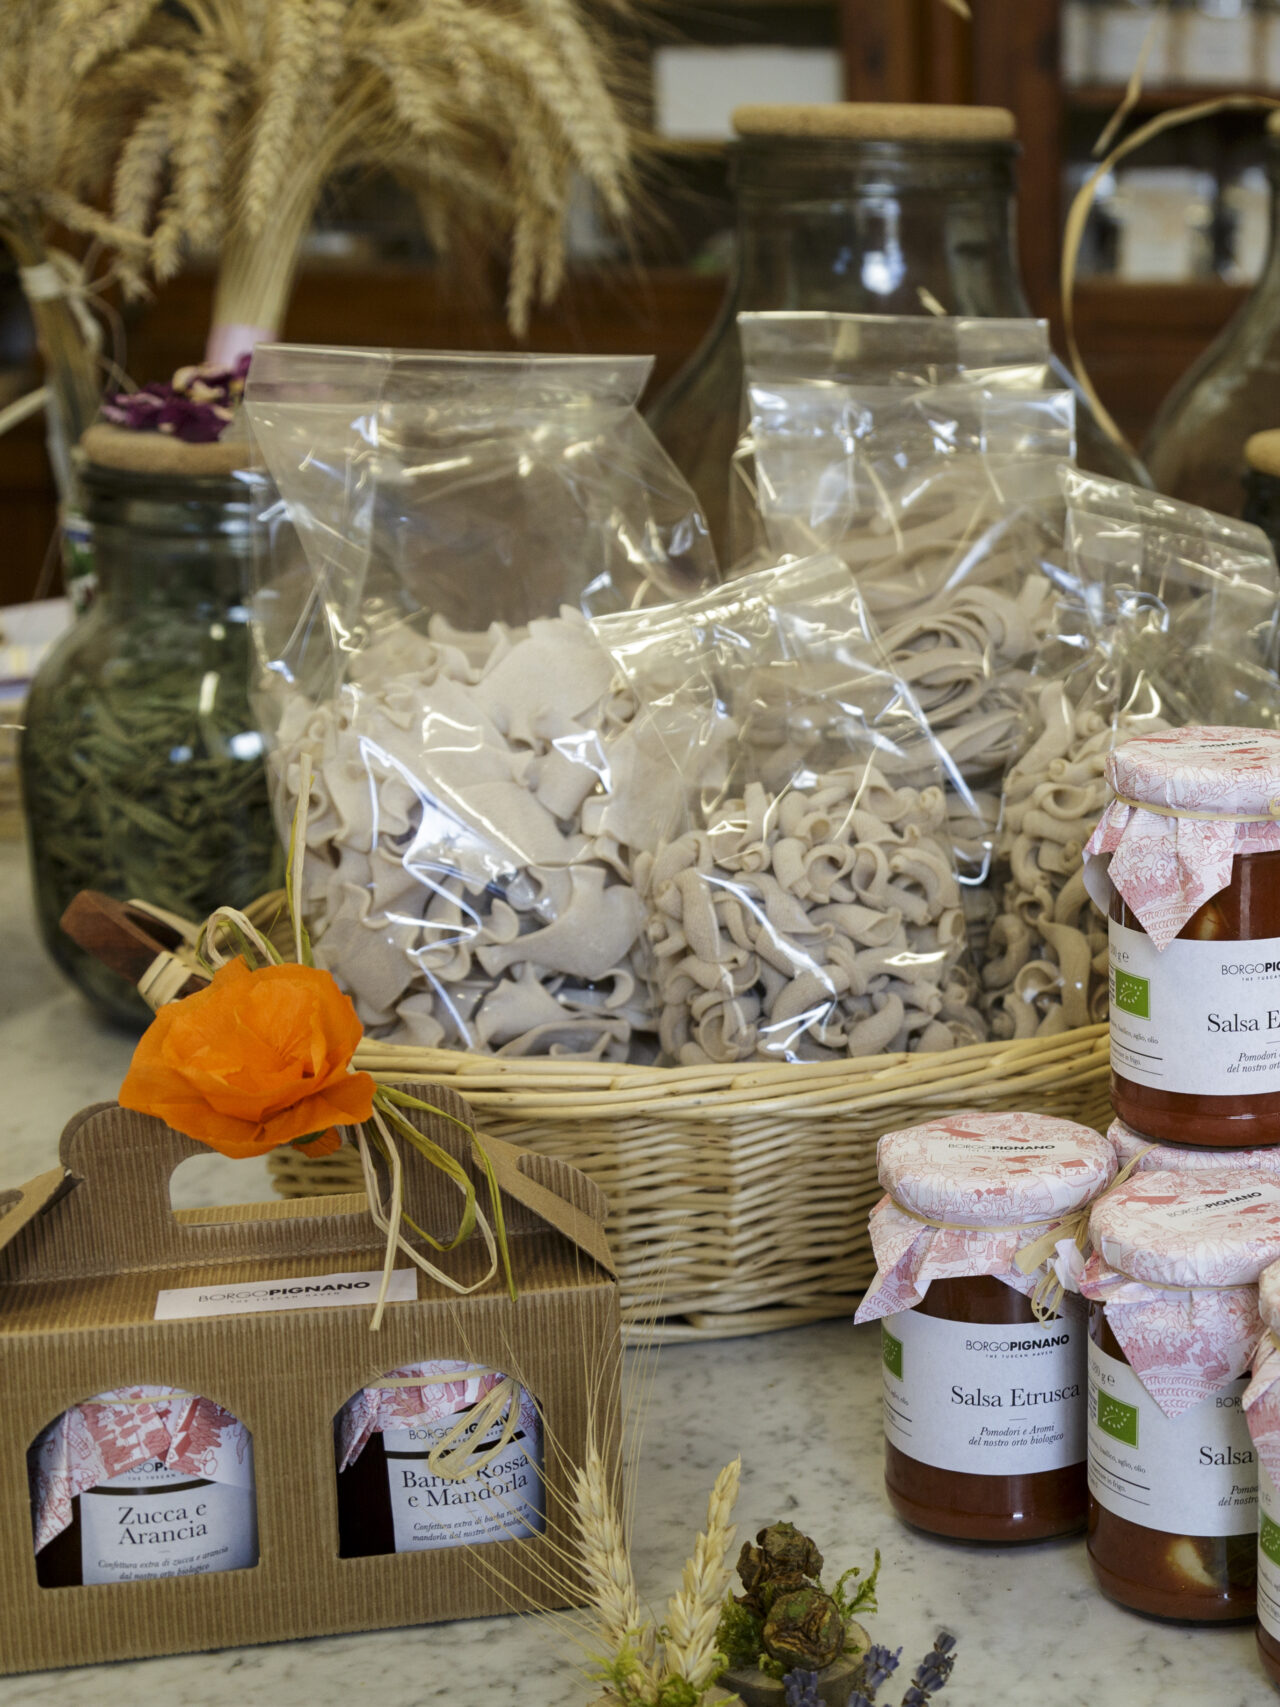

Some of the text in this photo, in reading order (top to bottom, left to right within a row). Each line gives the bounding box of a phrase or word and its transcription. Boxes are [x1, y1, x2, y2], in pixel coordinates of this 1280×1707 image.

[1208, 1013, 1258, 1032] Salsa
[1239, 1052, 1276, 1062] Pomodori
[1227, 1062, 1239, 1073] del
[1243, 1063, 1266, 1073] nostro
[199, 1281, 370, 1302] BORGOPIGNANO
[966, 1334, 1069, 1351] BORGOPIGNANO
[951, 1386, 1002, 1407] Salsa
[1010, 1384, 1080, 1407] Etrusca
[980, 1426, 1019, 1436] Pomodori
[1029, 1423, 1055, 1434] Aromi
[969, 1432, 1064, 1447] del nostro orto biologico
[1200, 1446, 1253, 1466] Salsa
[476, 1454, 529, 1482] Rossa
[408, 1473, 528, 1508] e Mandorla
[1219, 1497, 1231, 1507] del
[118, 1503, 207, 1526] Zucca e
[118, 1520, 208, 1545] Arancia
[413, 1531, 446, 1541] mandorla
[464, 1528, 485, 1537] nostro
[98, 1559, 137, 1571] Confettura
[162, 1557, 170, 1567] di
[173, 1557, 194, 1566] zucca
[202, 1546, 229, 1559] arancia
